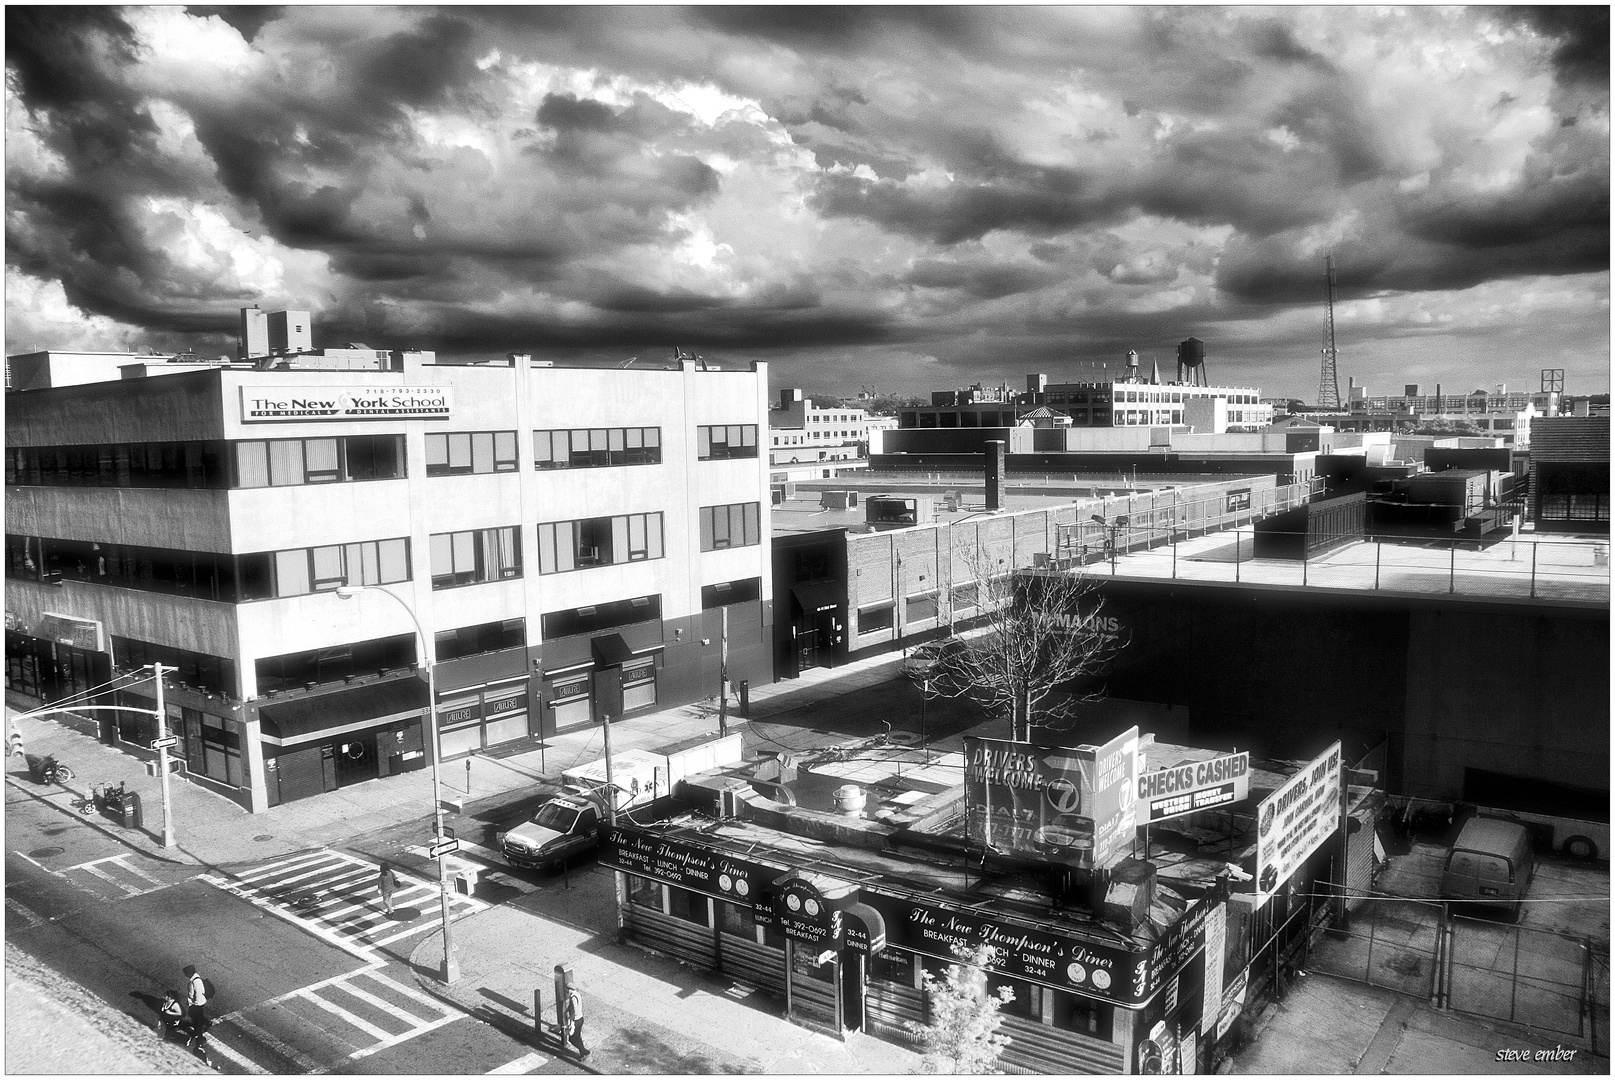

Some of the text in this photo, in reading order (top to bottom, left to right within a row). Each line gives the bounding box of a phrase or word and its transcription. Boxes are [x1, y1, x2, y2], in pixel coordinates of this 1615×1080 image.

[251, 396, 445, 409] The New York School
[974, 748, 1035, 772] DRIVERS
[1099, 748, 1122, 777] DRIVERS
[975, 766, 1044, 791] WELCOME
[1099, 762, 1126, 794] WELCOME
[1138, 754, 1248, 800] CHECKS CASHED
[1277, 776, 1308, 816] DRIVERS,
[1310, 760, 1327, 787] JOIN
[1327, 748, 1339, 774] US!
[1051, 782, 1074, 810] 7
[1195, 788, 1222, 800] MONEY
[1152, 795, 1190, 810] WESTERN
[1163, 803, 1190, 815] UNION
[1023, 808, 1034, 821] 7
[609, 830, 749, 879] The New Thompson's Diner
[619, 858, 633, 866] 32-44
[618, 849, 709, 881] BREAKFAST LUNCH DINNER
[654, 866, 682, 882] 392-0692
[755, 903, 773, 914] 32-44
[754, 914, 773, 925] LUNCH
[785, 927, 820, 942] BREAKFAST
[793, 920, 827, 937] 392-0692
[847, 928, 867, 940] 32-44
[847, 939, 868, 951] DINNER
[909, 907, 936, 927] The
[941, 916, 972, 935] New
[978, 923, 1065, 957] Thompson's
[1071, 945, 1114, 969] Diner
[923, 928, 968, 948] BREAKFAST
[1022, 953, 1056, 970] DINNER
[1024, 965, 1046, 977] 32-44
